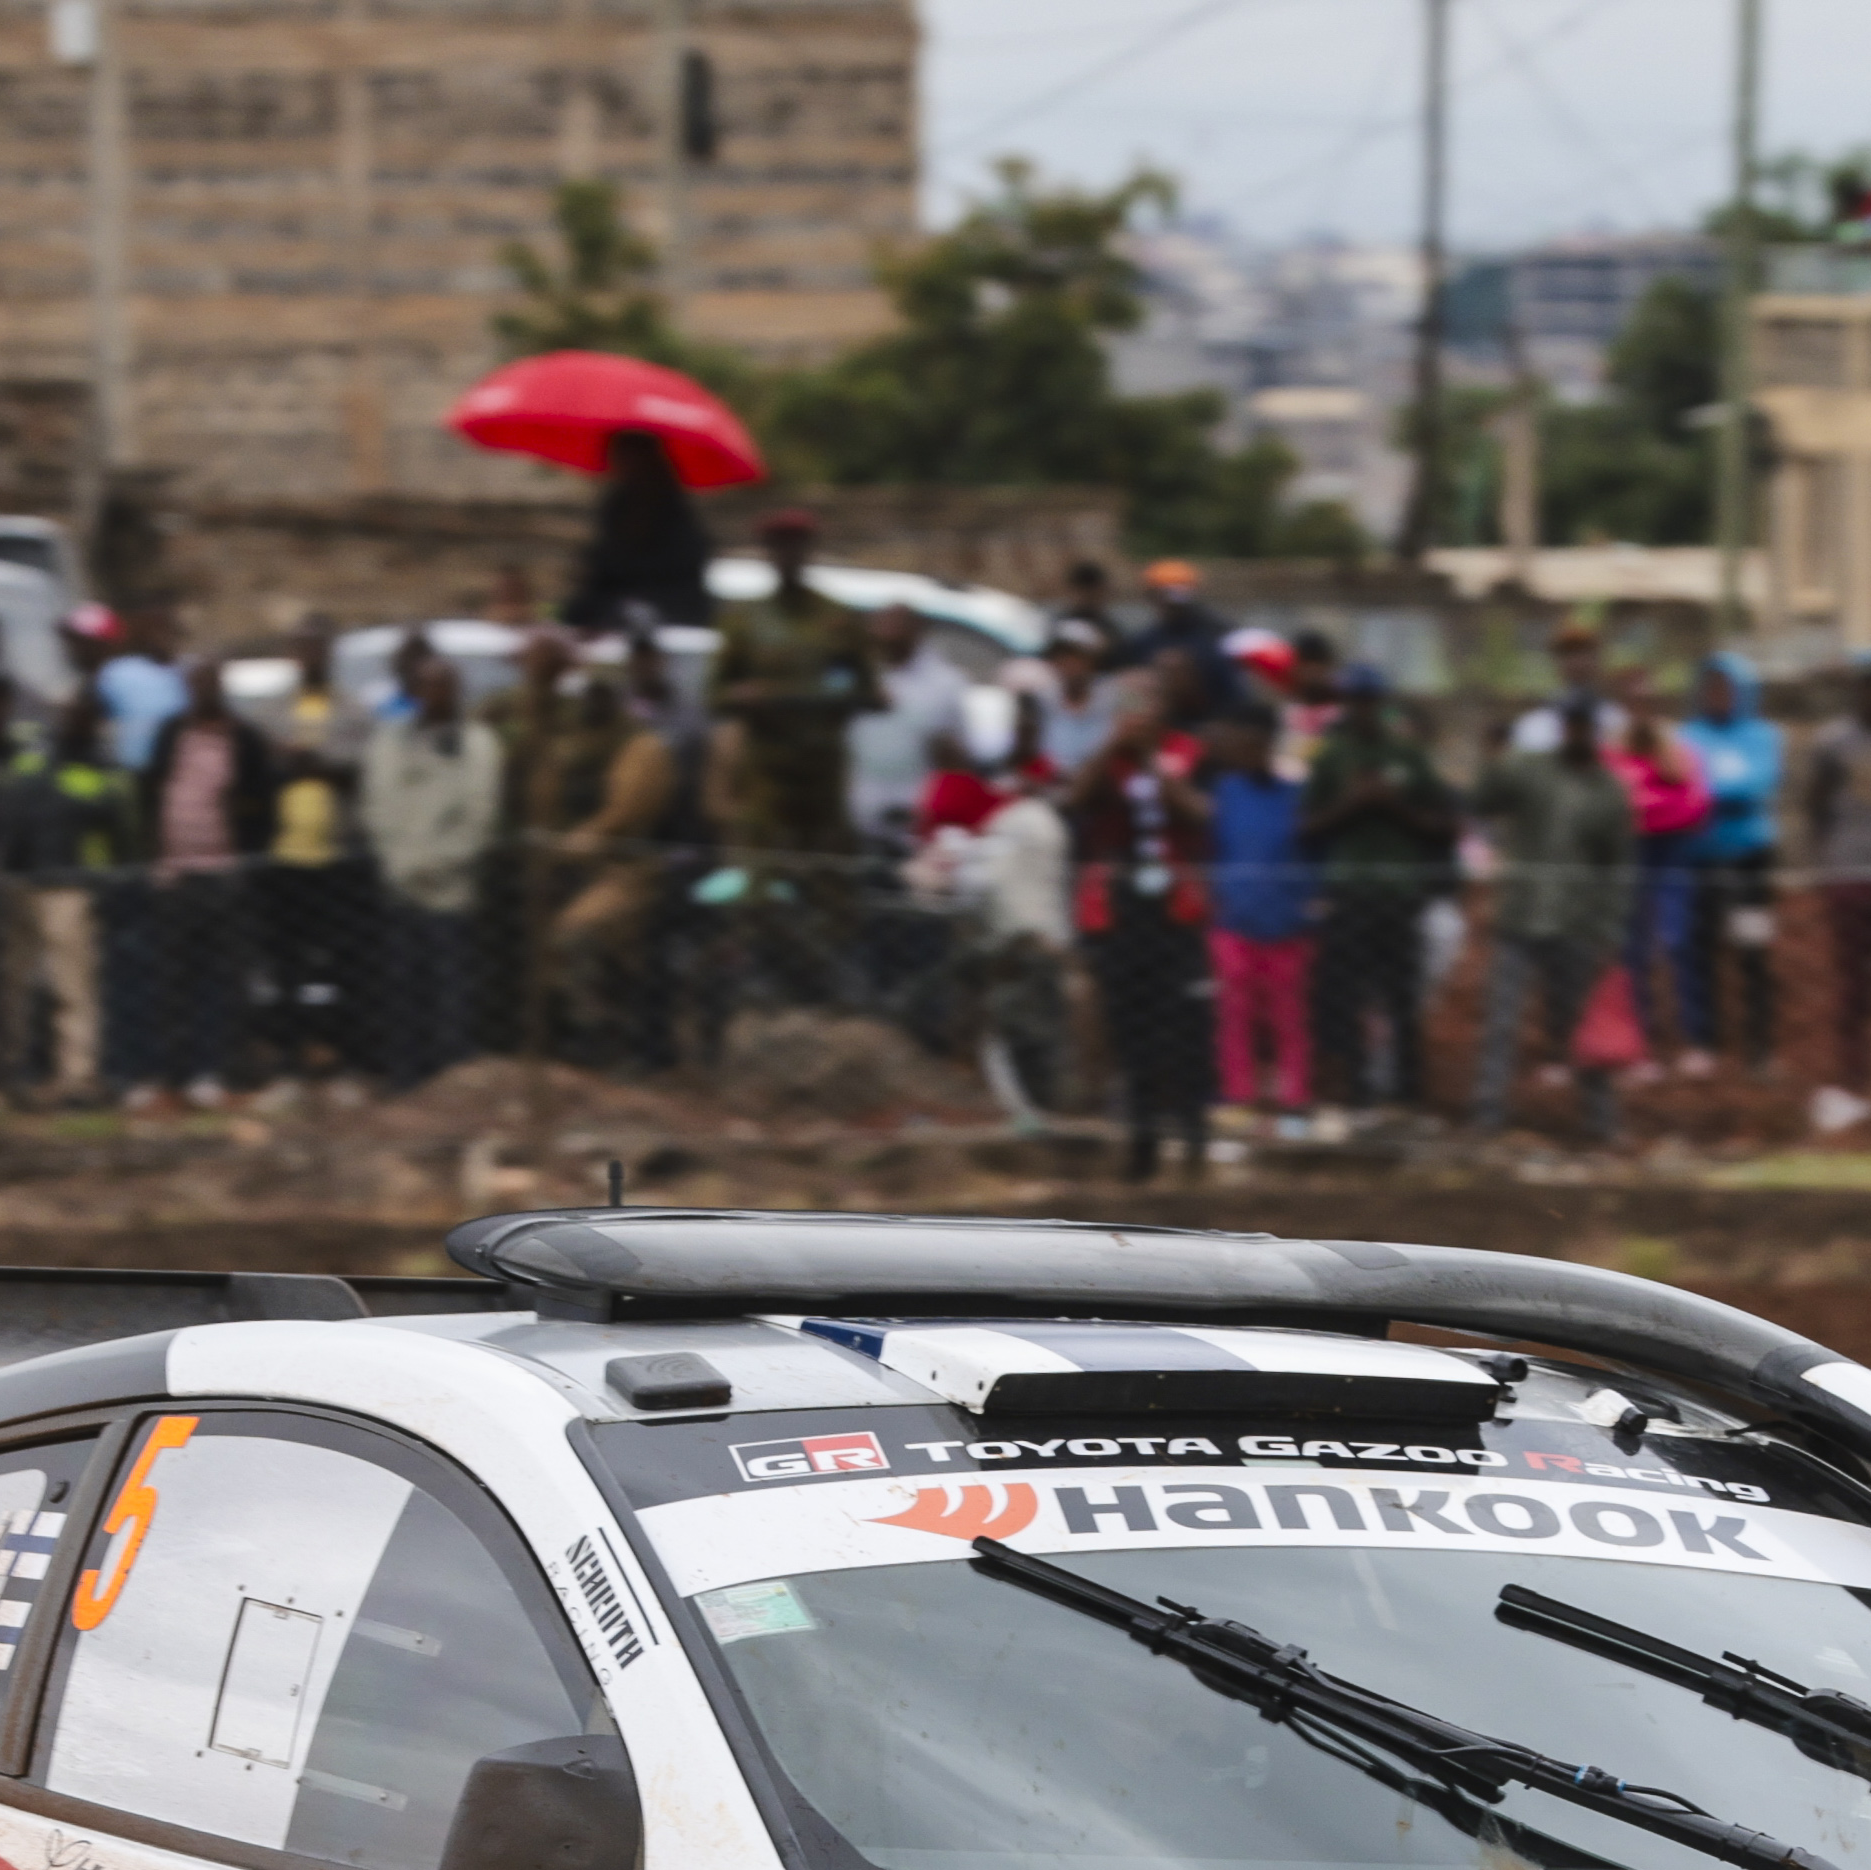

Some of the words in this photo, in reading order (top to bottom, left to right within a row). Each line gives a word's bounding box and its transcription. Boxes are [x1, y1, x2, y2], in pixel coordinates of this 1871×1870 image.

[745, 1446, 878, 1479] GR
[905, 1436, 1222, 1463] TOYOTA
[1238, 1435, 1508, 1467] GAZOO
[1522, 1450, 1771, 1502] Racing
[71, 1416, 201, 1631] 5
[565, 1534, 645, 1670] SCHROTH
